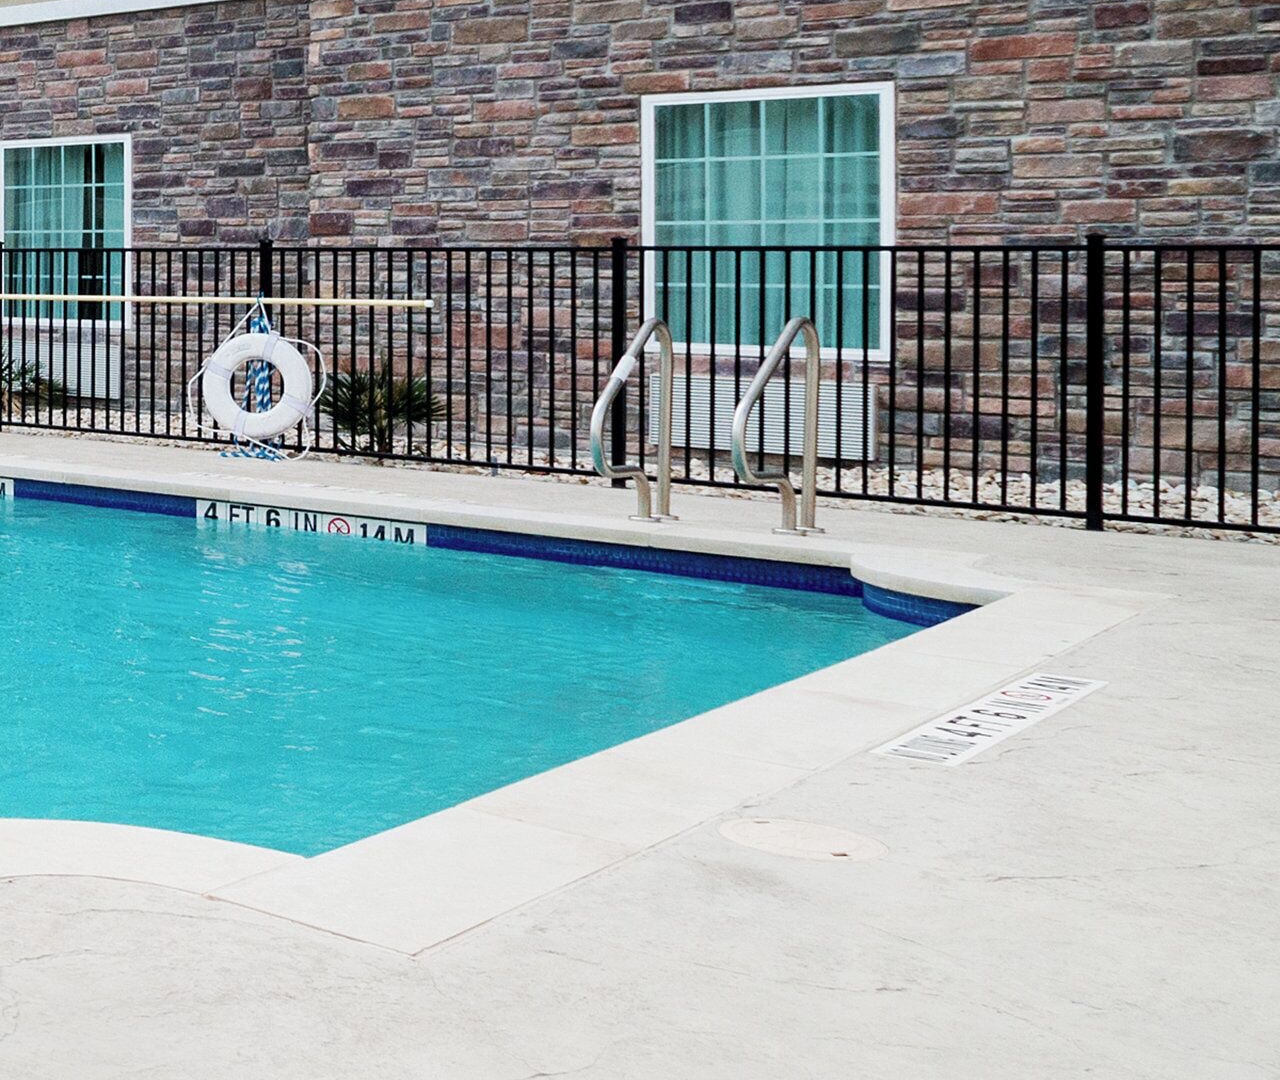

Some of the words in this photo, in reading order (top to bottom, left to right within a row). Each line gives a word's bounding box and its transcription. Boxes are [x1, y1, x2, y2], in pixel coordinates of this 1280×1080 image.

[204, 502, 218, 520] 4
[229, 504, 255, 524] FT
[266, 509, 280, 527] 6
[294, 512, 317, 532] IN
[971, 709, 1028, 720] 6
[948, 715, 1013, 732] FT
[936, 726, 993, 738] 4
